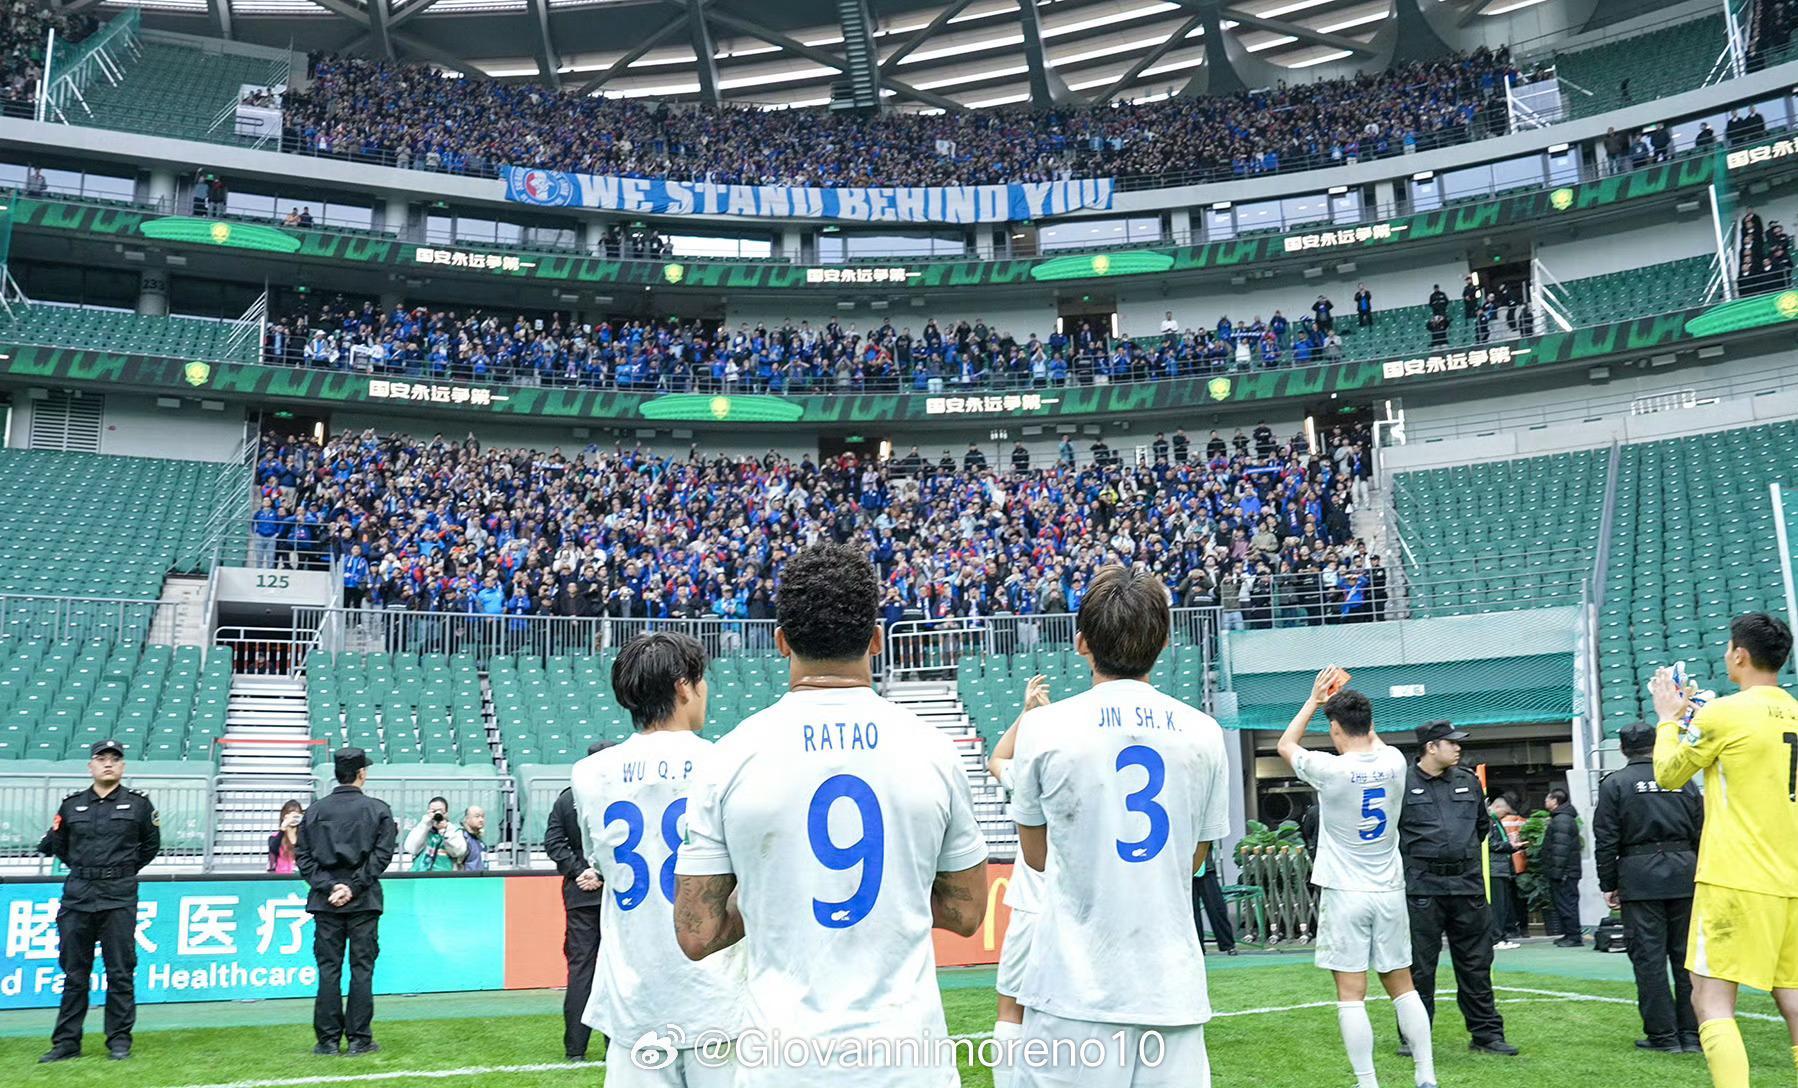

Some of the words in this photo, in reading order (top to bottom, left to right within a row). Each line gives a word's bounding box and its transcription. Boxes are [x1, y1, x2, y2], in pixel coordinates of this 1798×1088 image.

[1727, 137, 1798, 169] 国安永
[574, 173, 651, 213] WE
[665, 180, 823, 217] STAND
[837, 184, 1008, 223] BEHIND
[1022, 178, 1112, 219] YOU
[1383, 346, 1531, 379] 国安永远争第一
[369, 380, 510, 405] 国安永远争第一
[256, 574, 289, 588] 125
[1098, 706, 1121, 727] JIN
[803, 721, 879, 752] RATAO
[622, 761, 646, 783] WU
[1115, 744, 1170, 863] 3
[1358, 787, 1387, 840] 5
[807, 773, 885, 929] 9
[148, 960, 316, 990] Healthcare
